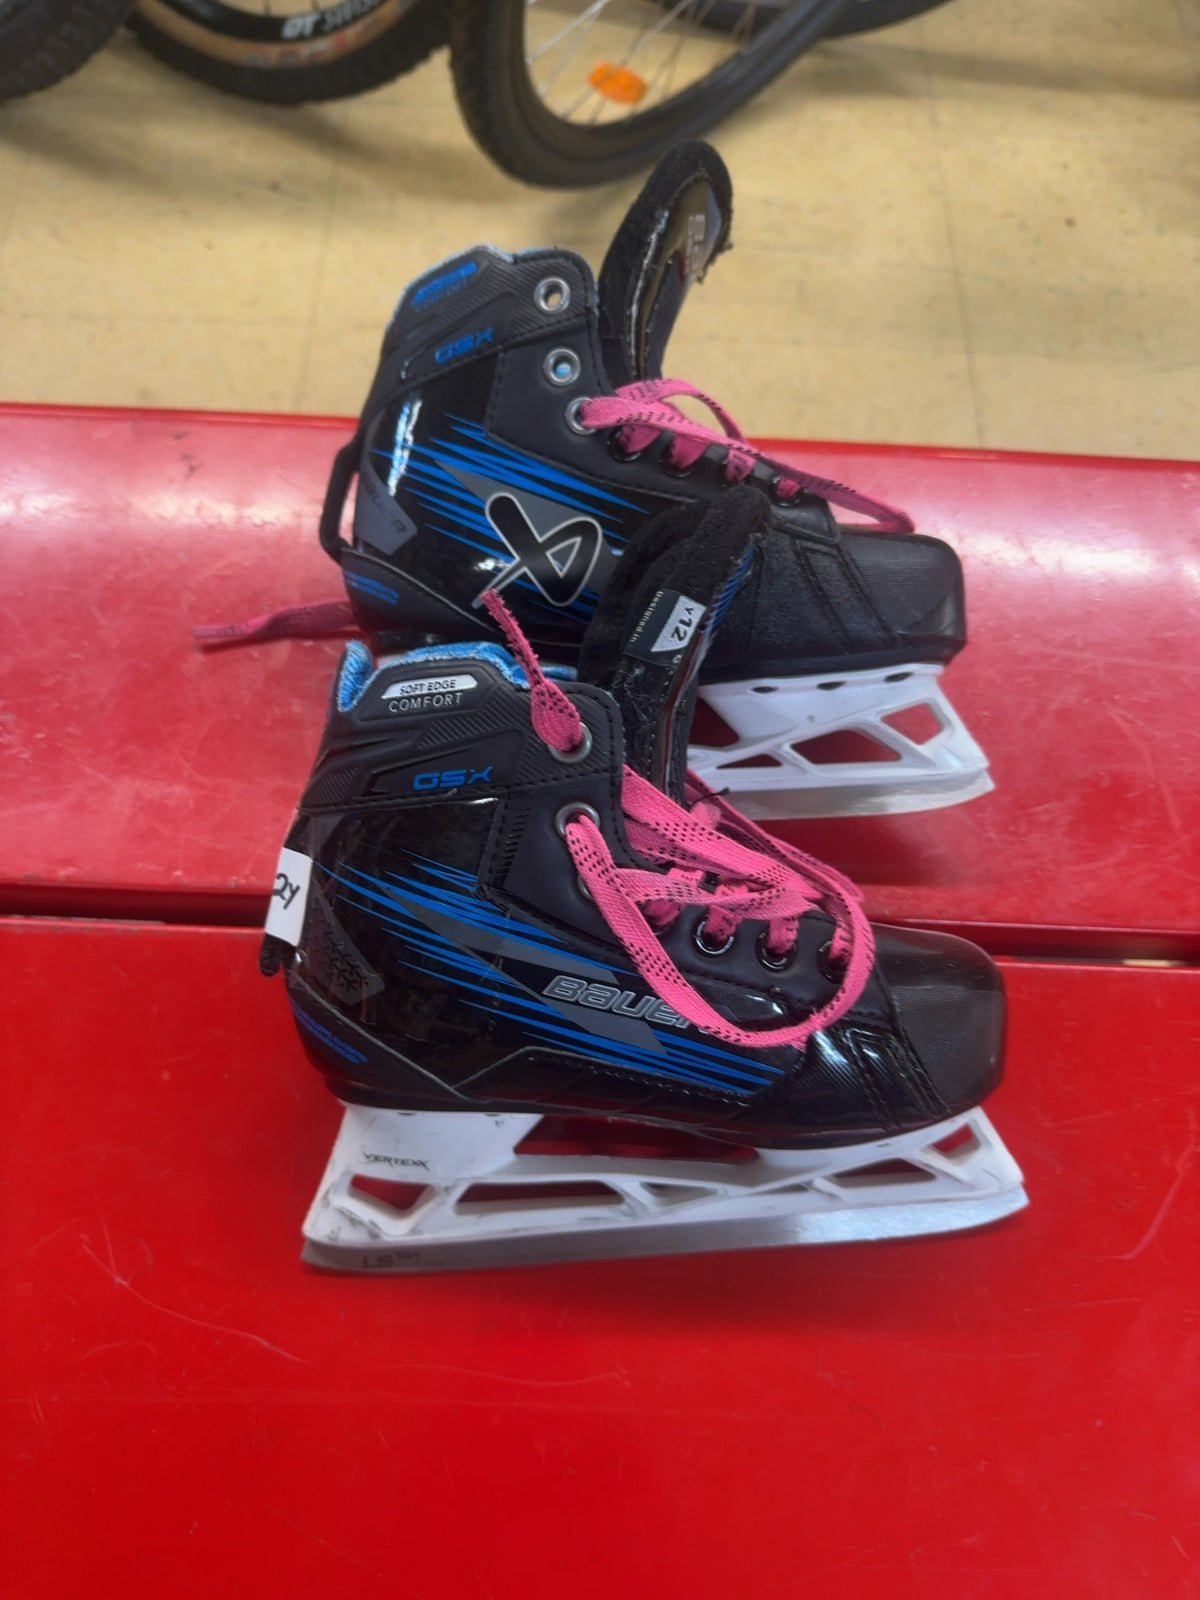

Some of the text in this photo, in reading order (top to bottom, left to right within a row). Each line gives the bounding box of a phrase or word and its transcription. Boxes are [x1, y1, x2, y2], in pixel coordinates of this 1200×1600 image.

[399, 679, 457, 696] SOFT EDGE
[388, 692, 463, 713] COMFORT
[413, 766, 493, 791] GSX
